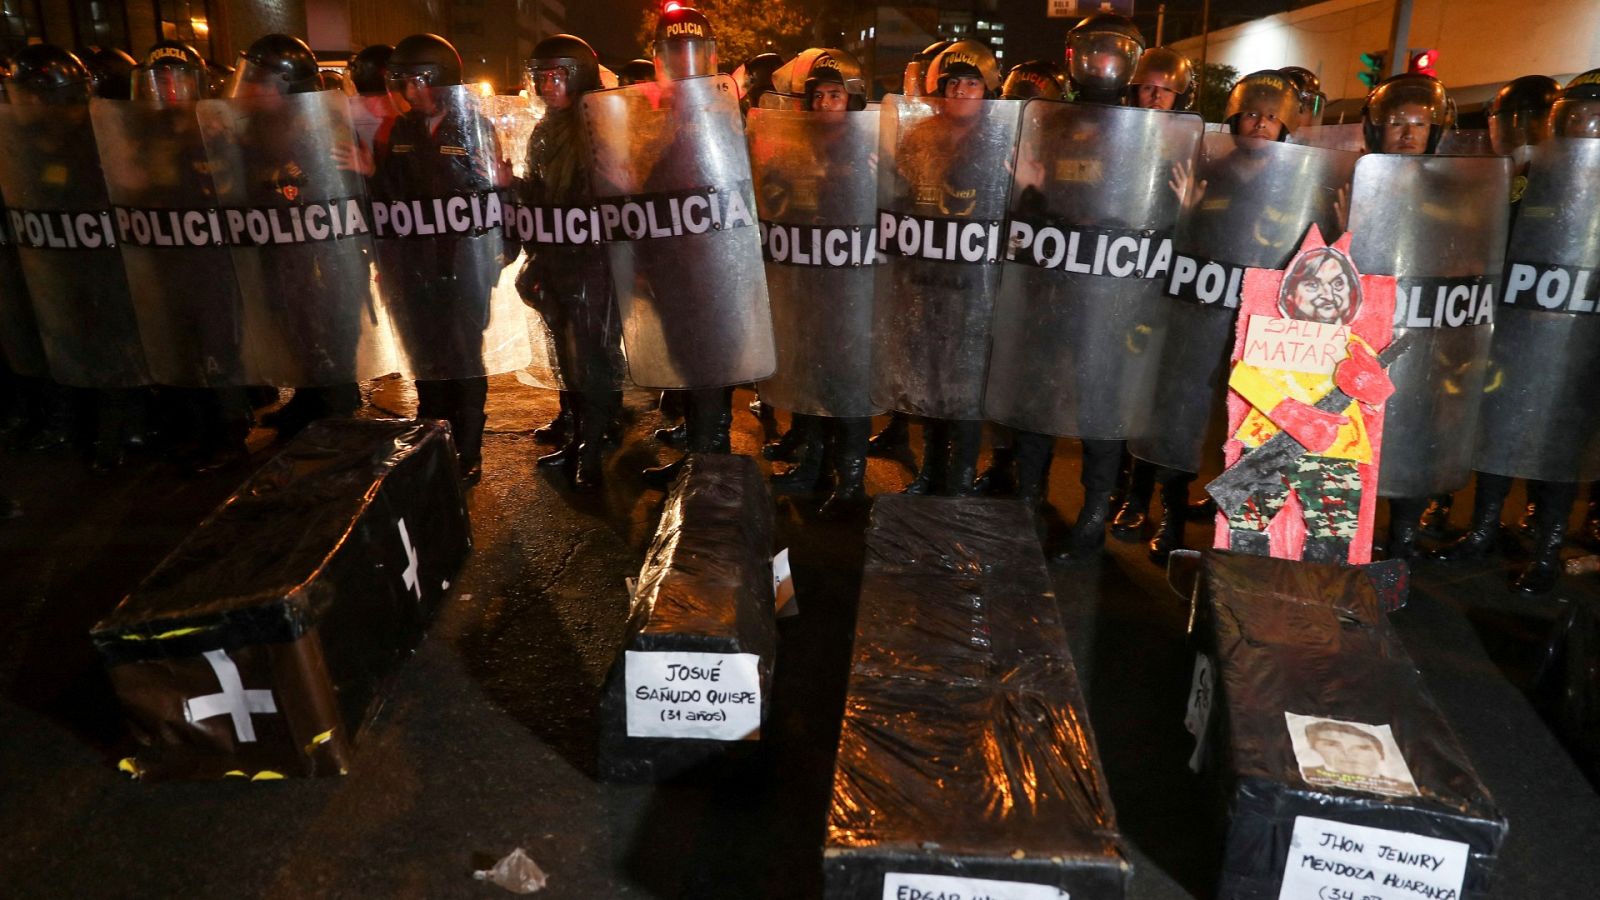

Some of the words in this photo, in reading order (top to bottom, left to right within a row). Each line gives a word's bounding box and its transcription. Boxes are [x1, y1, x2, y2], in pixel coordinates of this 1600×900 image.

[667, 22, 704, 38] POLICIA
[10, 210, 115, 249] POLICI
[115, 207, 223, 246] POLICI
[226, 199, 369, 245] POLICIA
[372, 193, 503, 237] POLICIA
[504, 204, 599, 245] POLICI
[601, 190, 754, 241] POLICIA
[880, 212, 999, 263] POLICI
[1006, 220, 1174, 279] POLICIA
[1504, 263, 1600, 312] POL
[1264, 318, 1321, 339] SALI
[1332, 324, 1347, 342] A
[1246, 340, 1337, 367] MATAR
[665, 660, 723, 682] JOSUÉ
[635, 685, 701, 703] SAÑUDO
[706, 689, 756, 705] QUISPE
[685, 709, 727, 722] años)
[1302, 854, 1376, 881] MENDOZA
[1319, 831, 1365, 854] JHON
[1377, 844, 1445, 871] JENNRY
